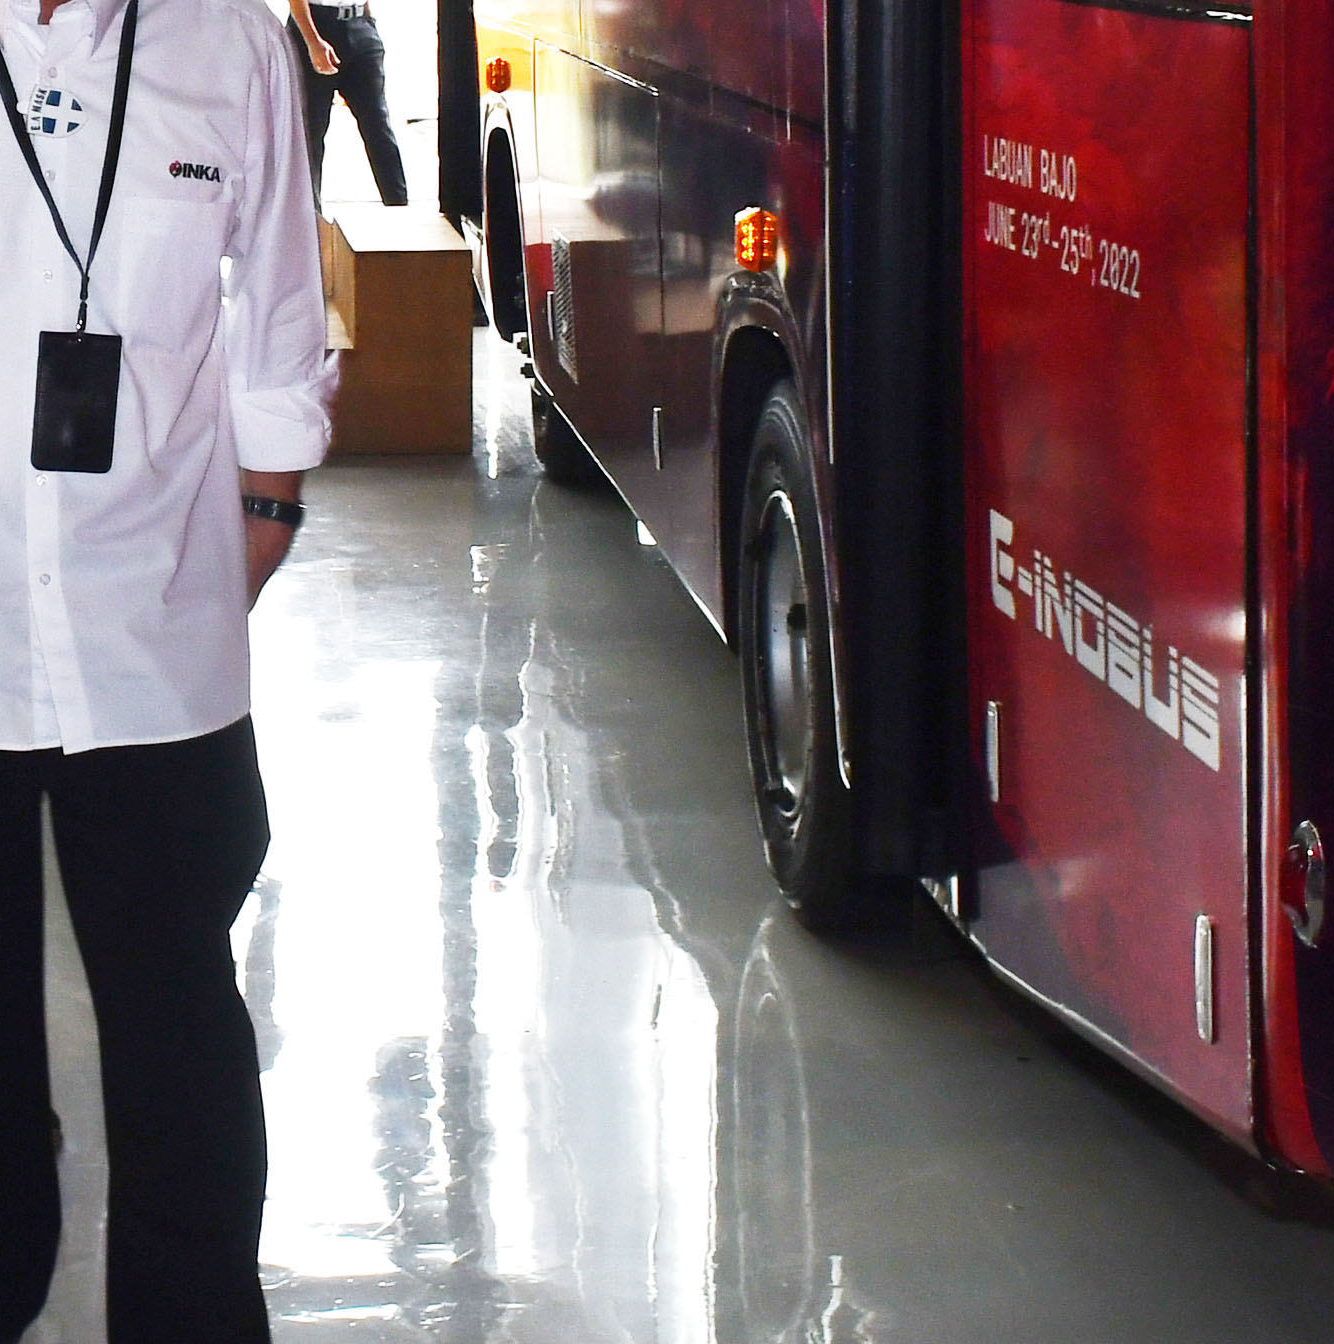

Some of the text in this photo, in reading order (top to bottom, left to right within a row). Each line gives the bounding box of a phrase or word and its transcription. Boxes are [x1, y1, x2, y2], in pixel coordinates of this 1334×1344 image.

[31, 88, 48, 113] MASK
[183, 163, 220, 183] INKA
[984, 135, 1077, 202] LABUAN BAJO
[984, 201, 1016, 251] JUNE
